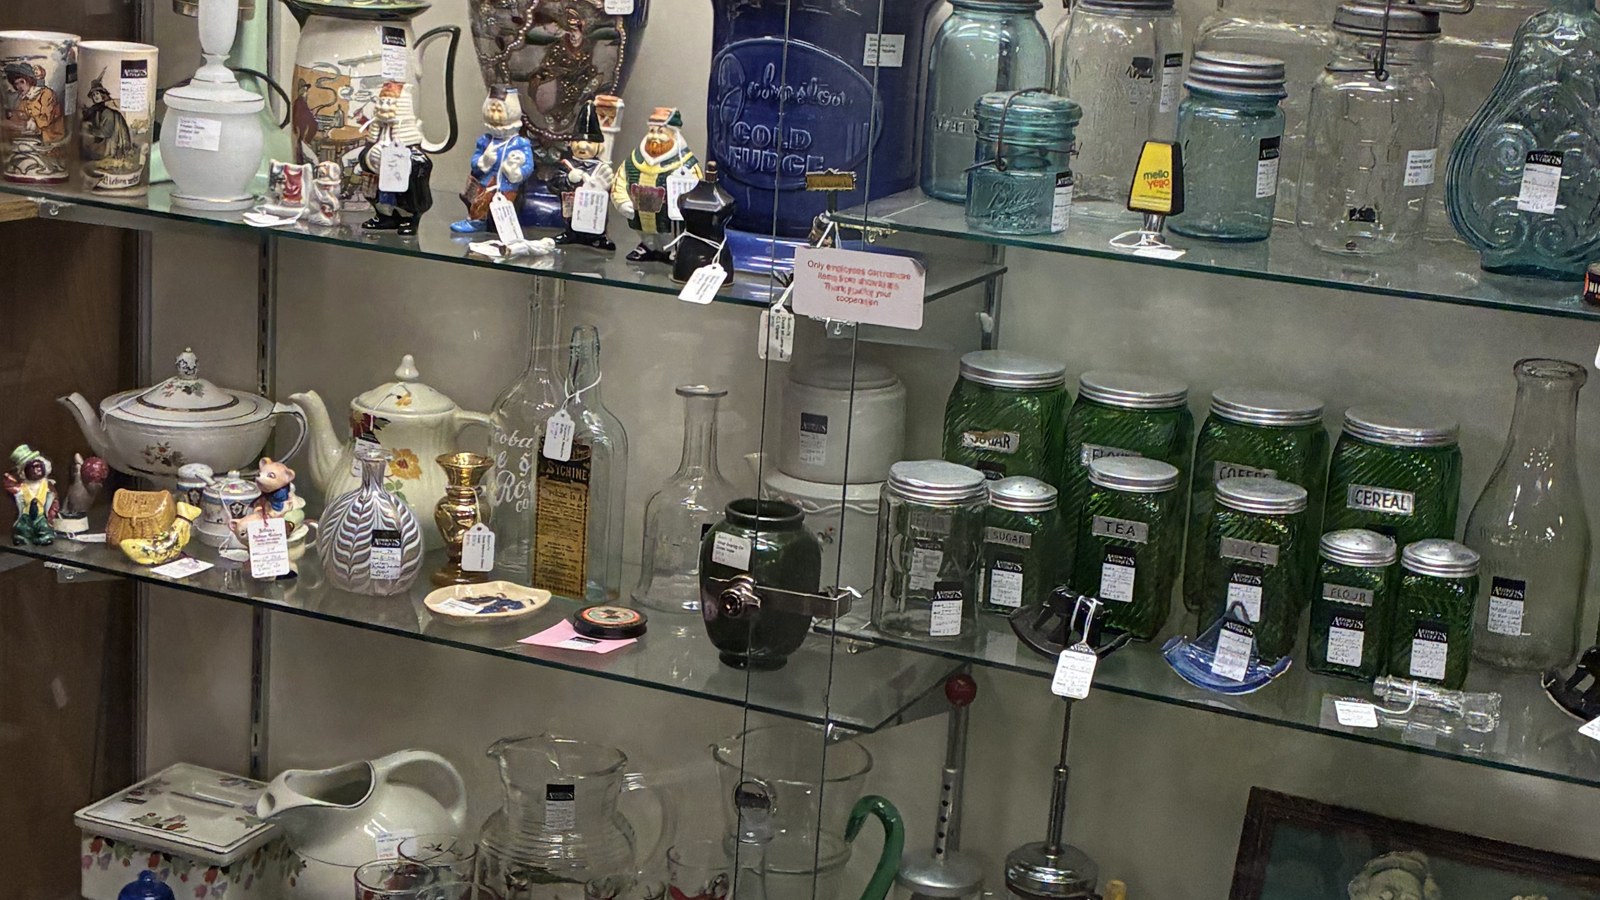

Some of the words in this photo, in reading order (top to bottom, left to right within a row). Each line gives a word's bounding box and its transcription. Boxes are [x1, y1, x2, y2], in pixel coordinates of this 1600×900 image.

[733, 121, 812, 151] GOLD
[728, 146, 824, 174] FUDGE
[1143, 169, 1170, 180] mello
[807, 260, 825, 270] Only
[1354, 489, 1408, 511] CEREAL
[1104, 520, 1136, 537] TEA
[992, 530, 1025, 545] SUGAR
